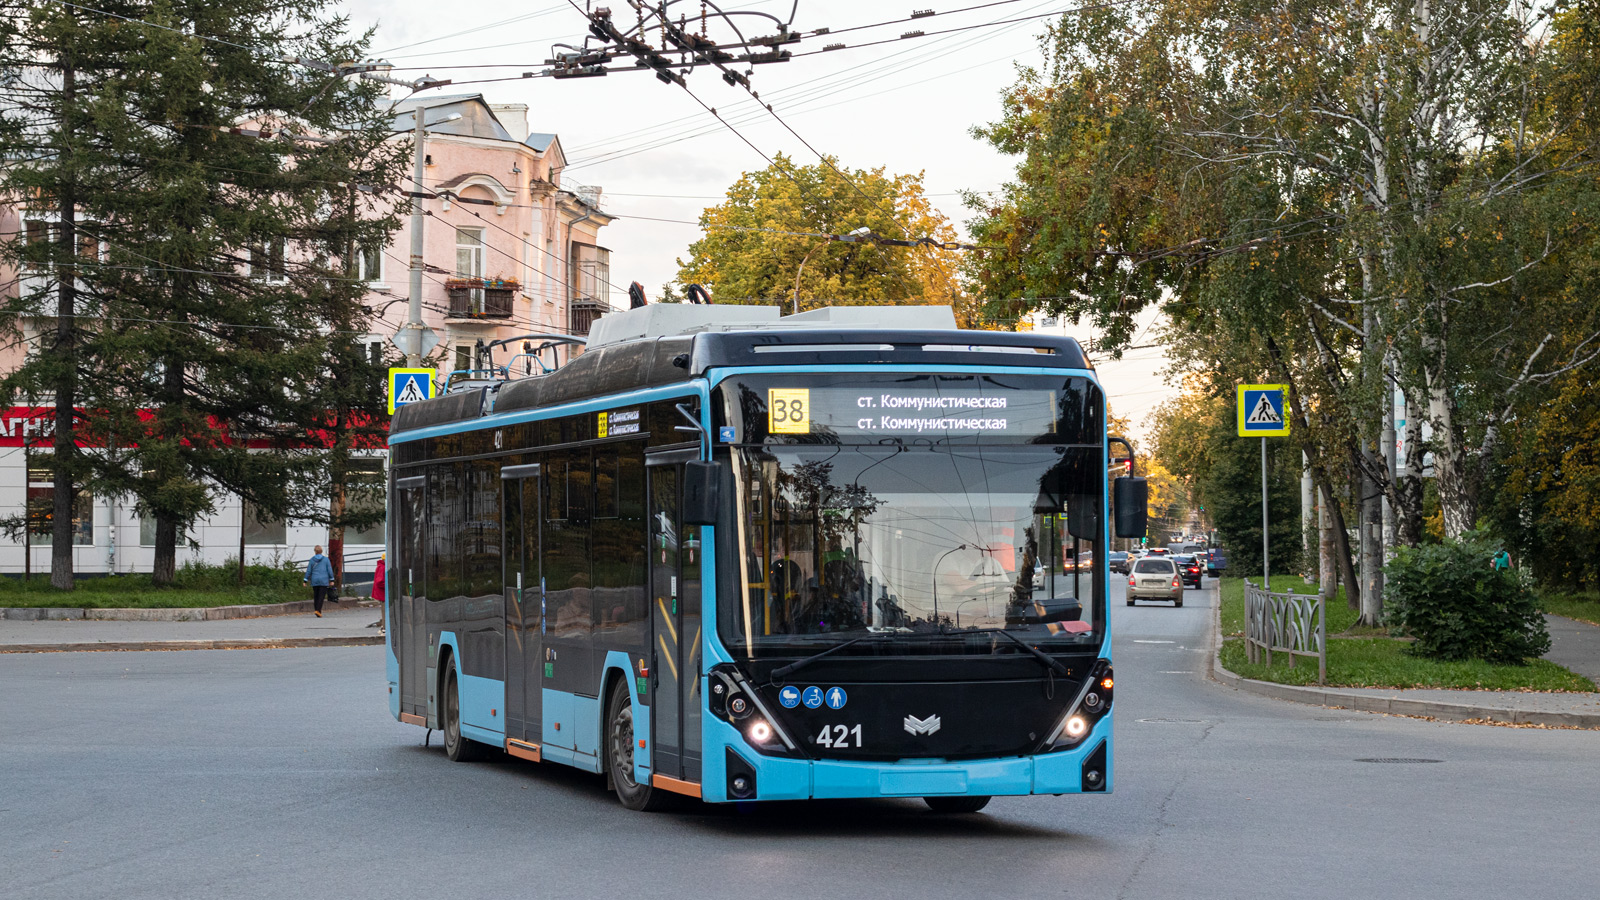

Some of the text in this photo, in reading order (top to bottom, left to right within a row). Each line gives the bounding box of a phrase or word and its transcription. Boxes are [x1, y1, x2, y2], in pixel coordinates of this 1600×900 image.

[774, 400, 803, 422] 38
[857, 395, 1007, 410] ст. Коммунистическая
[857, 416, 1007, 432] ст. Коммунистическая
[816, 724, 861, 748] 421
